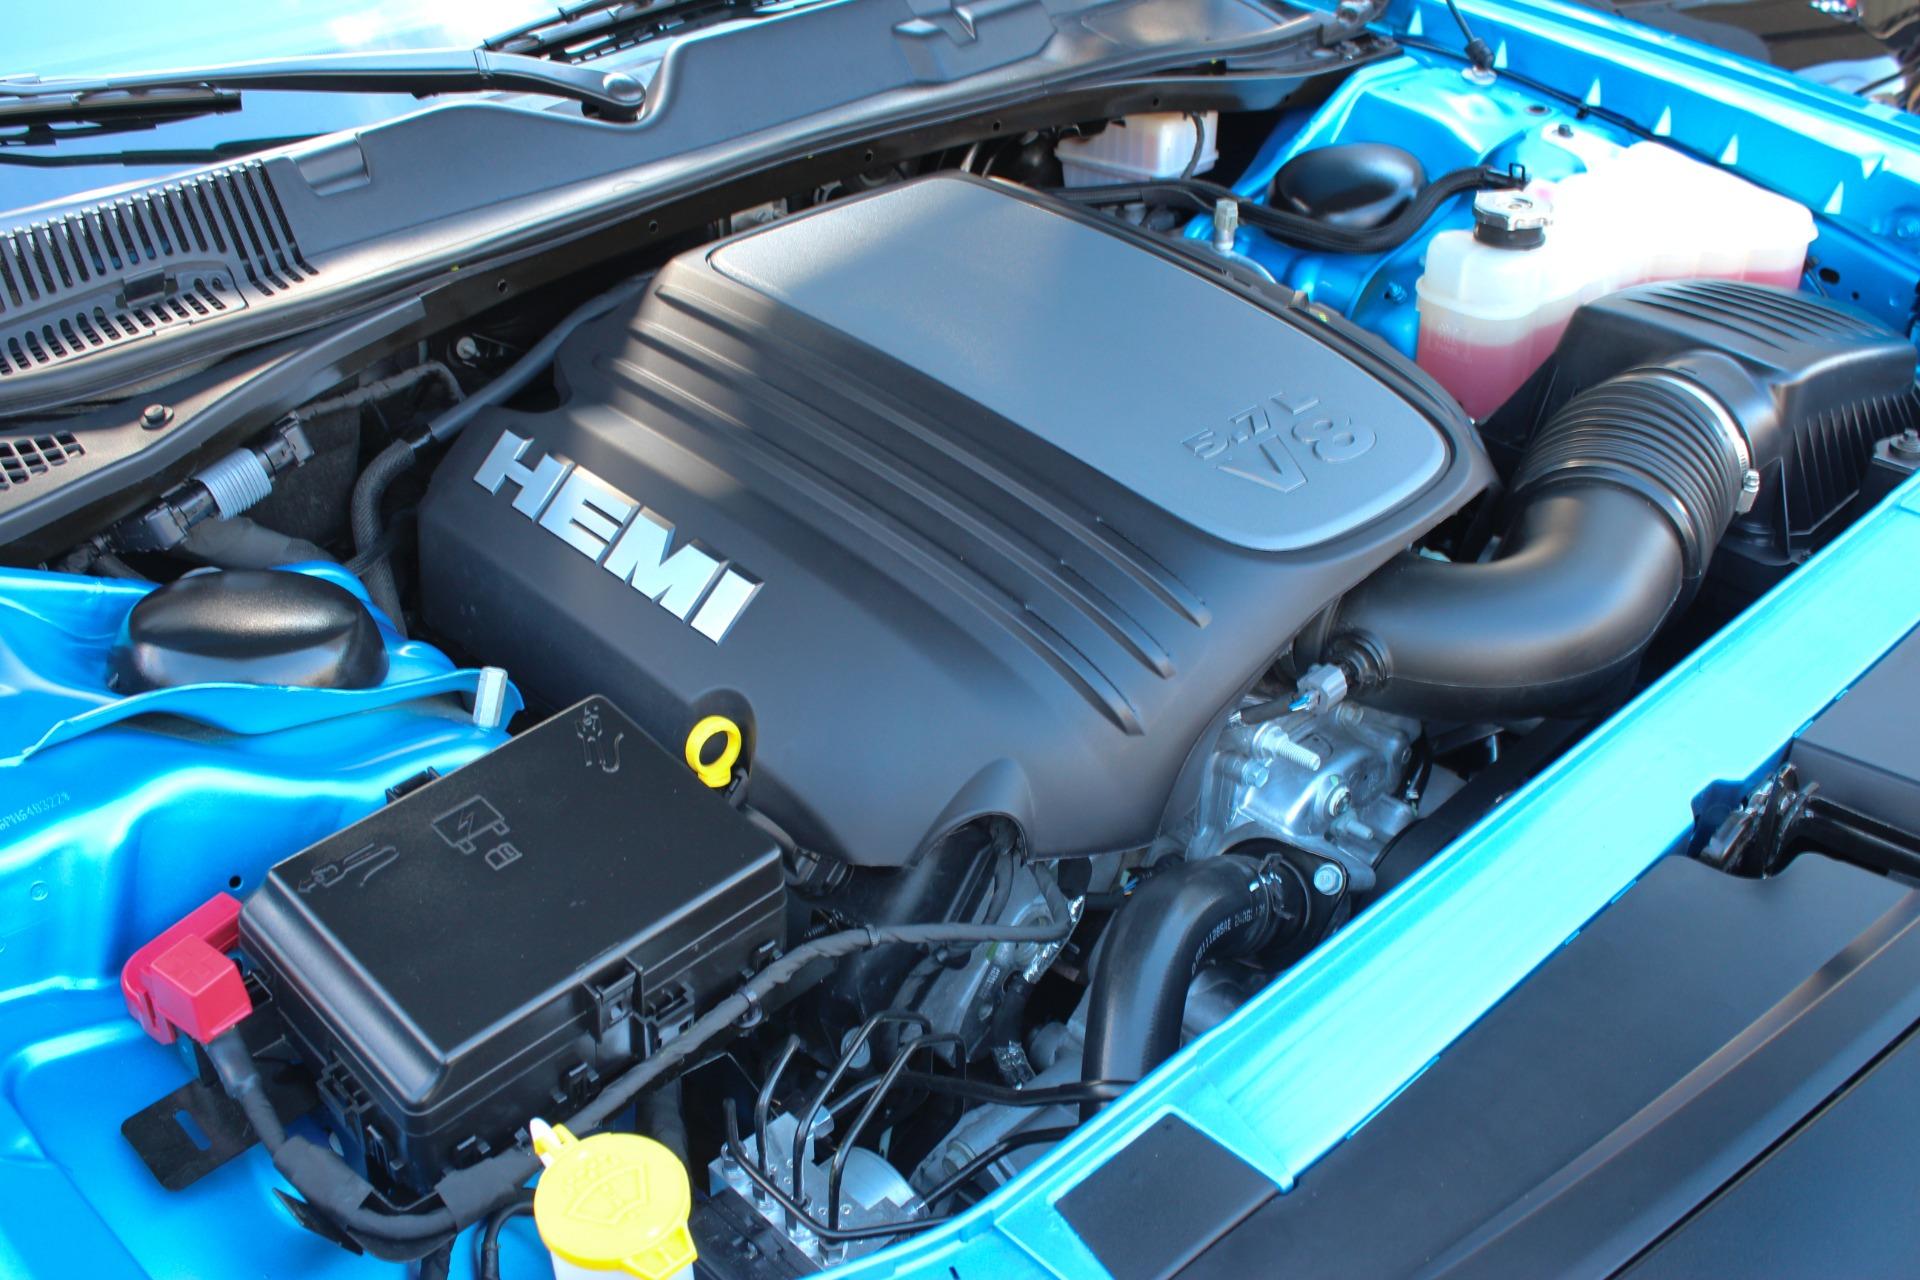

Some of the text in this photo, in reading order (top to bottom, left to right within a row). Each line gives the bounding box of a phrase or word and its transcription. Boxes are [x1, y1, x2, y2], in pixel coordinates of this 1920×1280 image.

[1181, 391, 1320, 461] 5.7L
[1216, 414, 1377, 493] V8
[473, 429, 765, 646] HEMI
